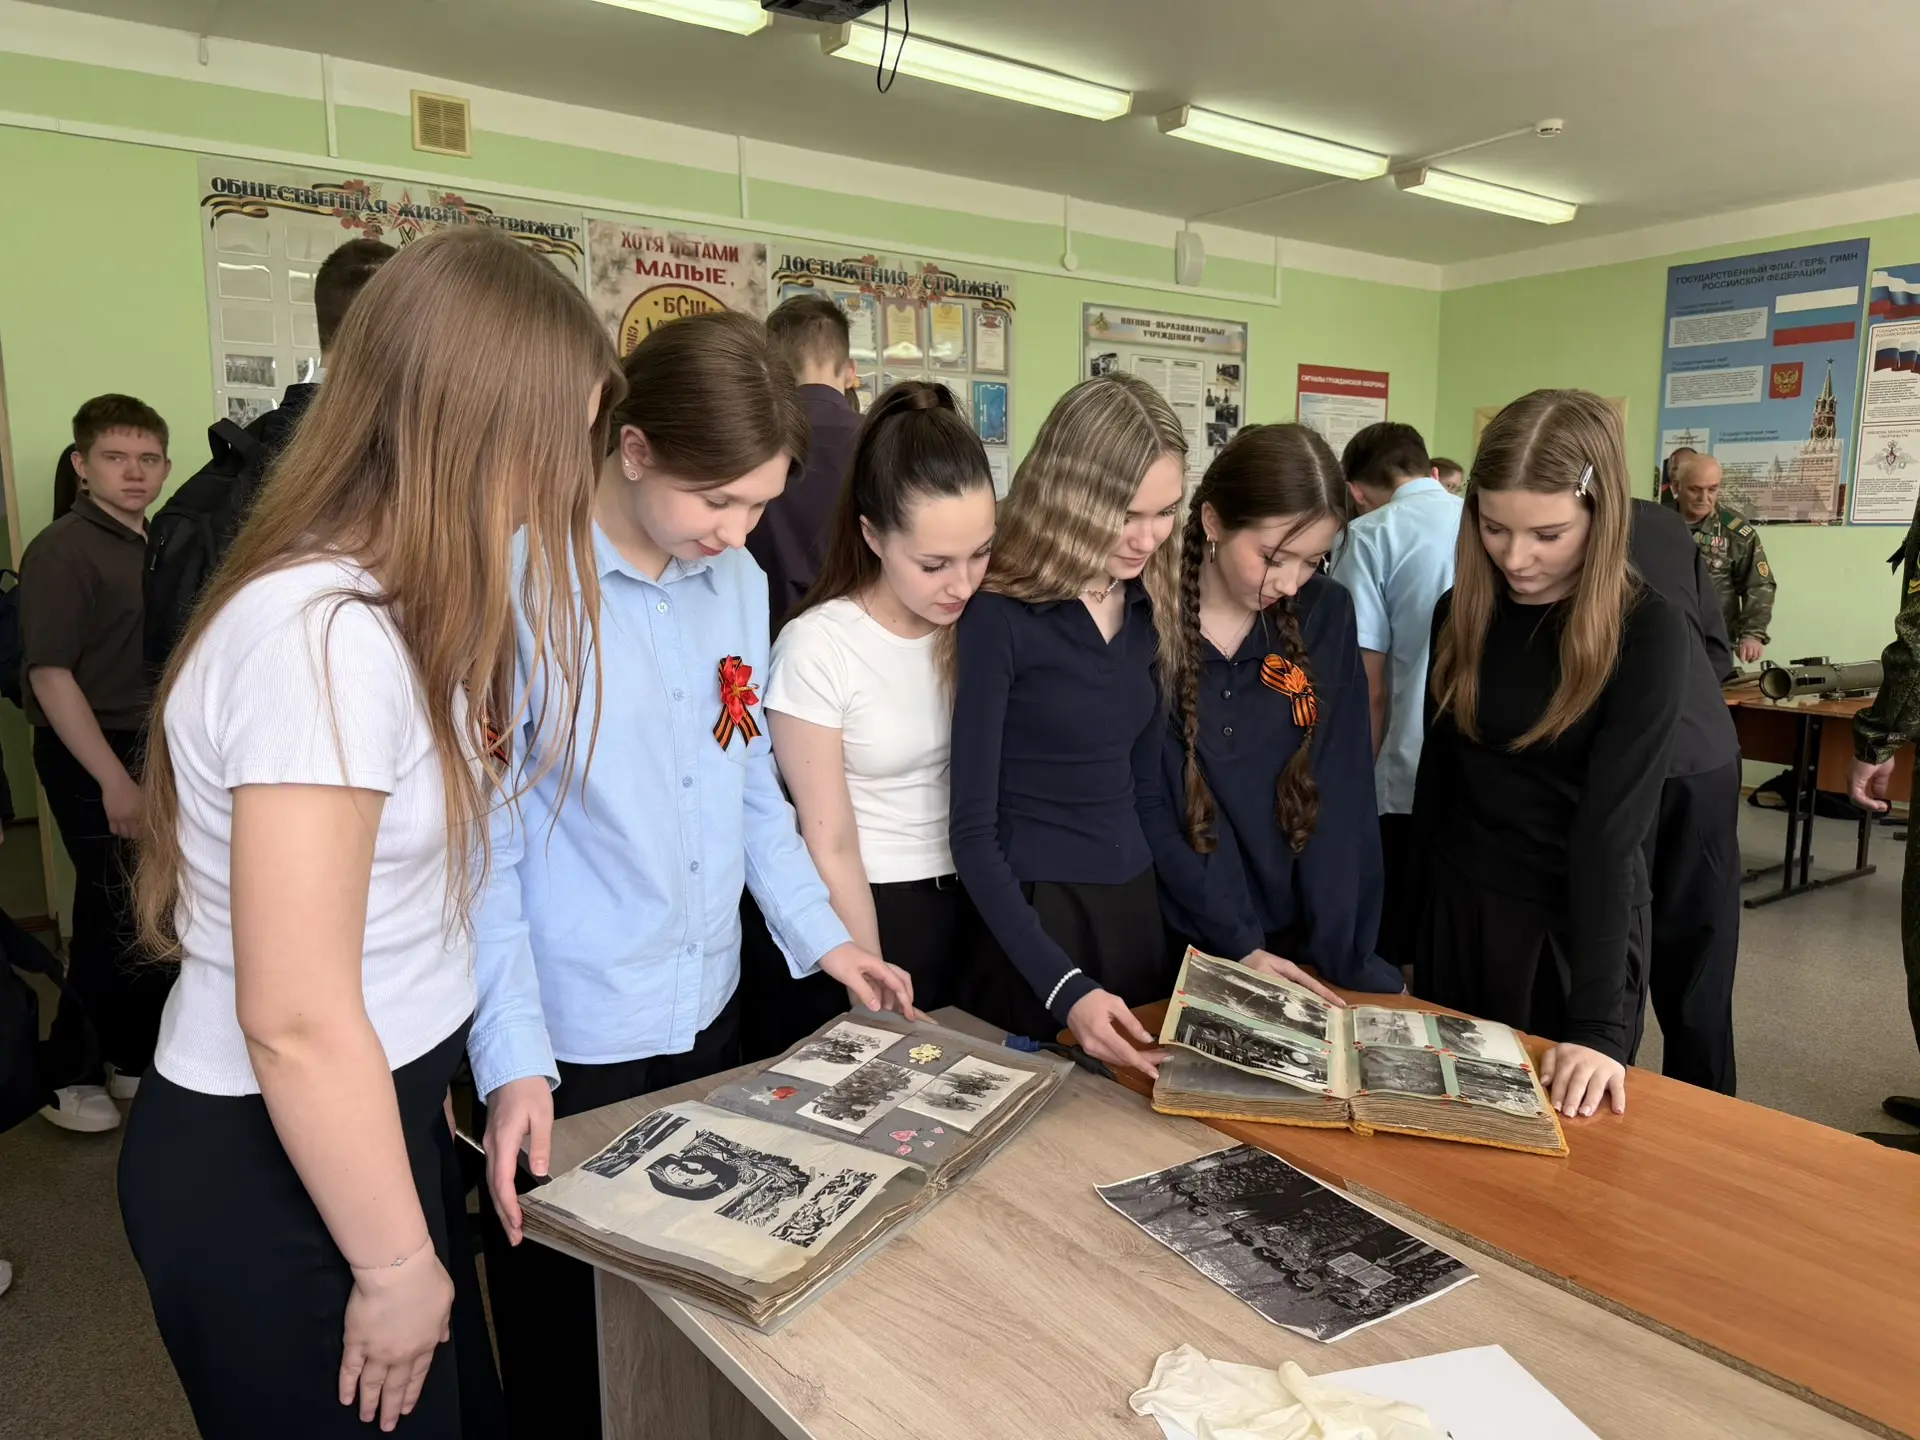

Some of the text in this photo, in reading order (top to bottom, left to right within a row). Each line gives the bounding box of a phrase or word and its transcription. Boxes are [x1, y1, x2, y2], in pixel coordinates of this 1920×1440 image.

[211, 176, 388, 214] ОБЩЕСТВЕННАЯ
[399, 202, 469, 226] ЖИЗНЬ
[621, 230, 664, 253] ХОТЯ
[779, 254, 908, 286] ДОСТИЖЕНИЯ
[1676, 263, 1768, 285] ГОСУДАРСТВЕННЫЙ
[1830, 252, 1858, 264] ГИМН
[1702, 267, 1827, 291] РОССИЙСКОЙ ФЕДЕРАЦИИ
